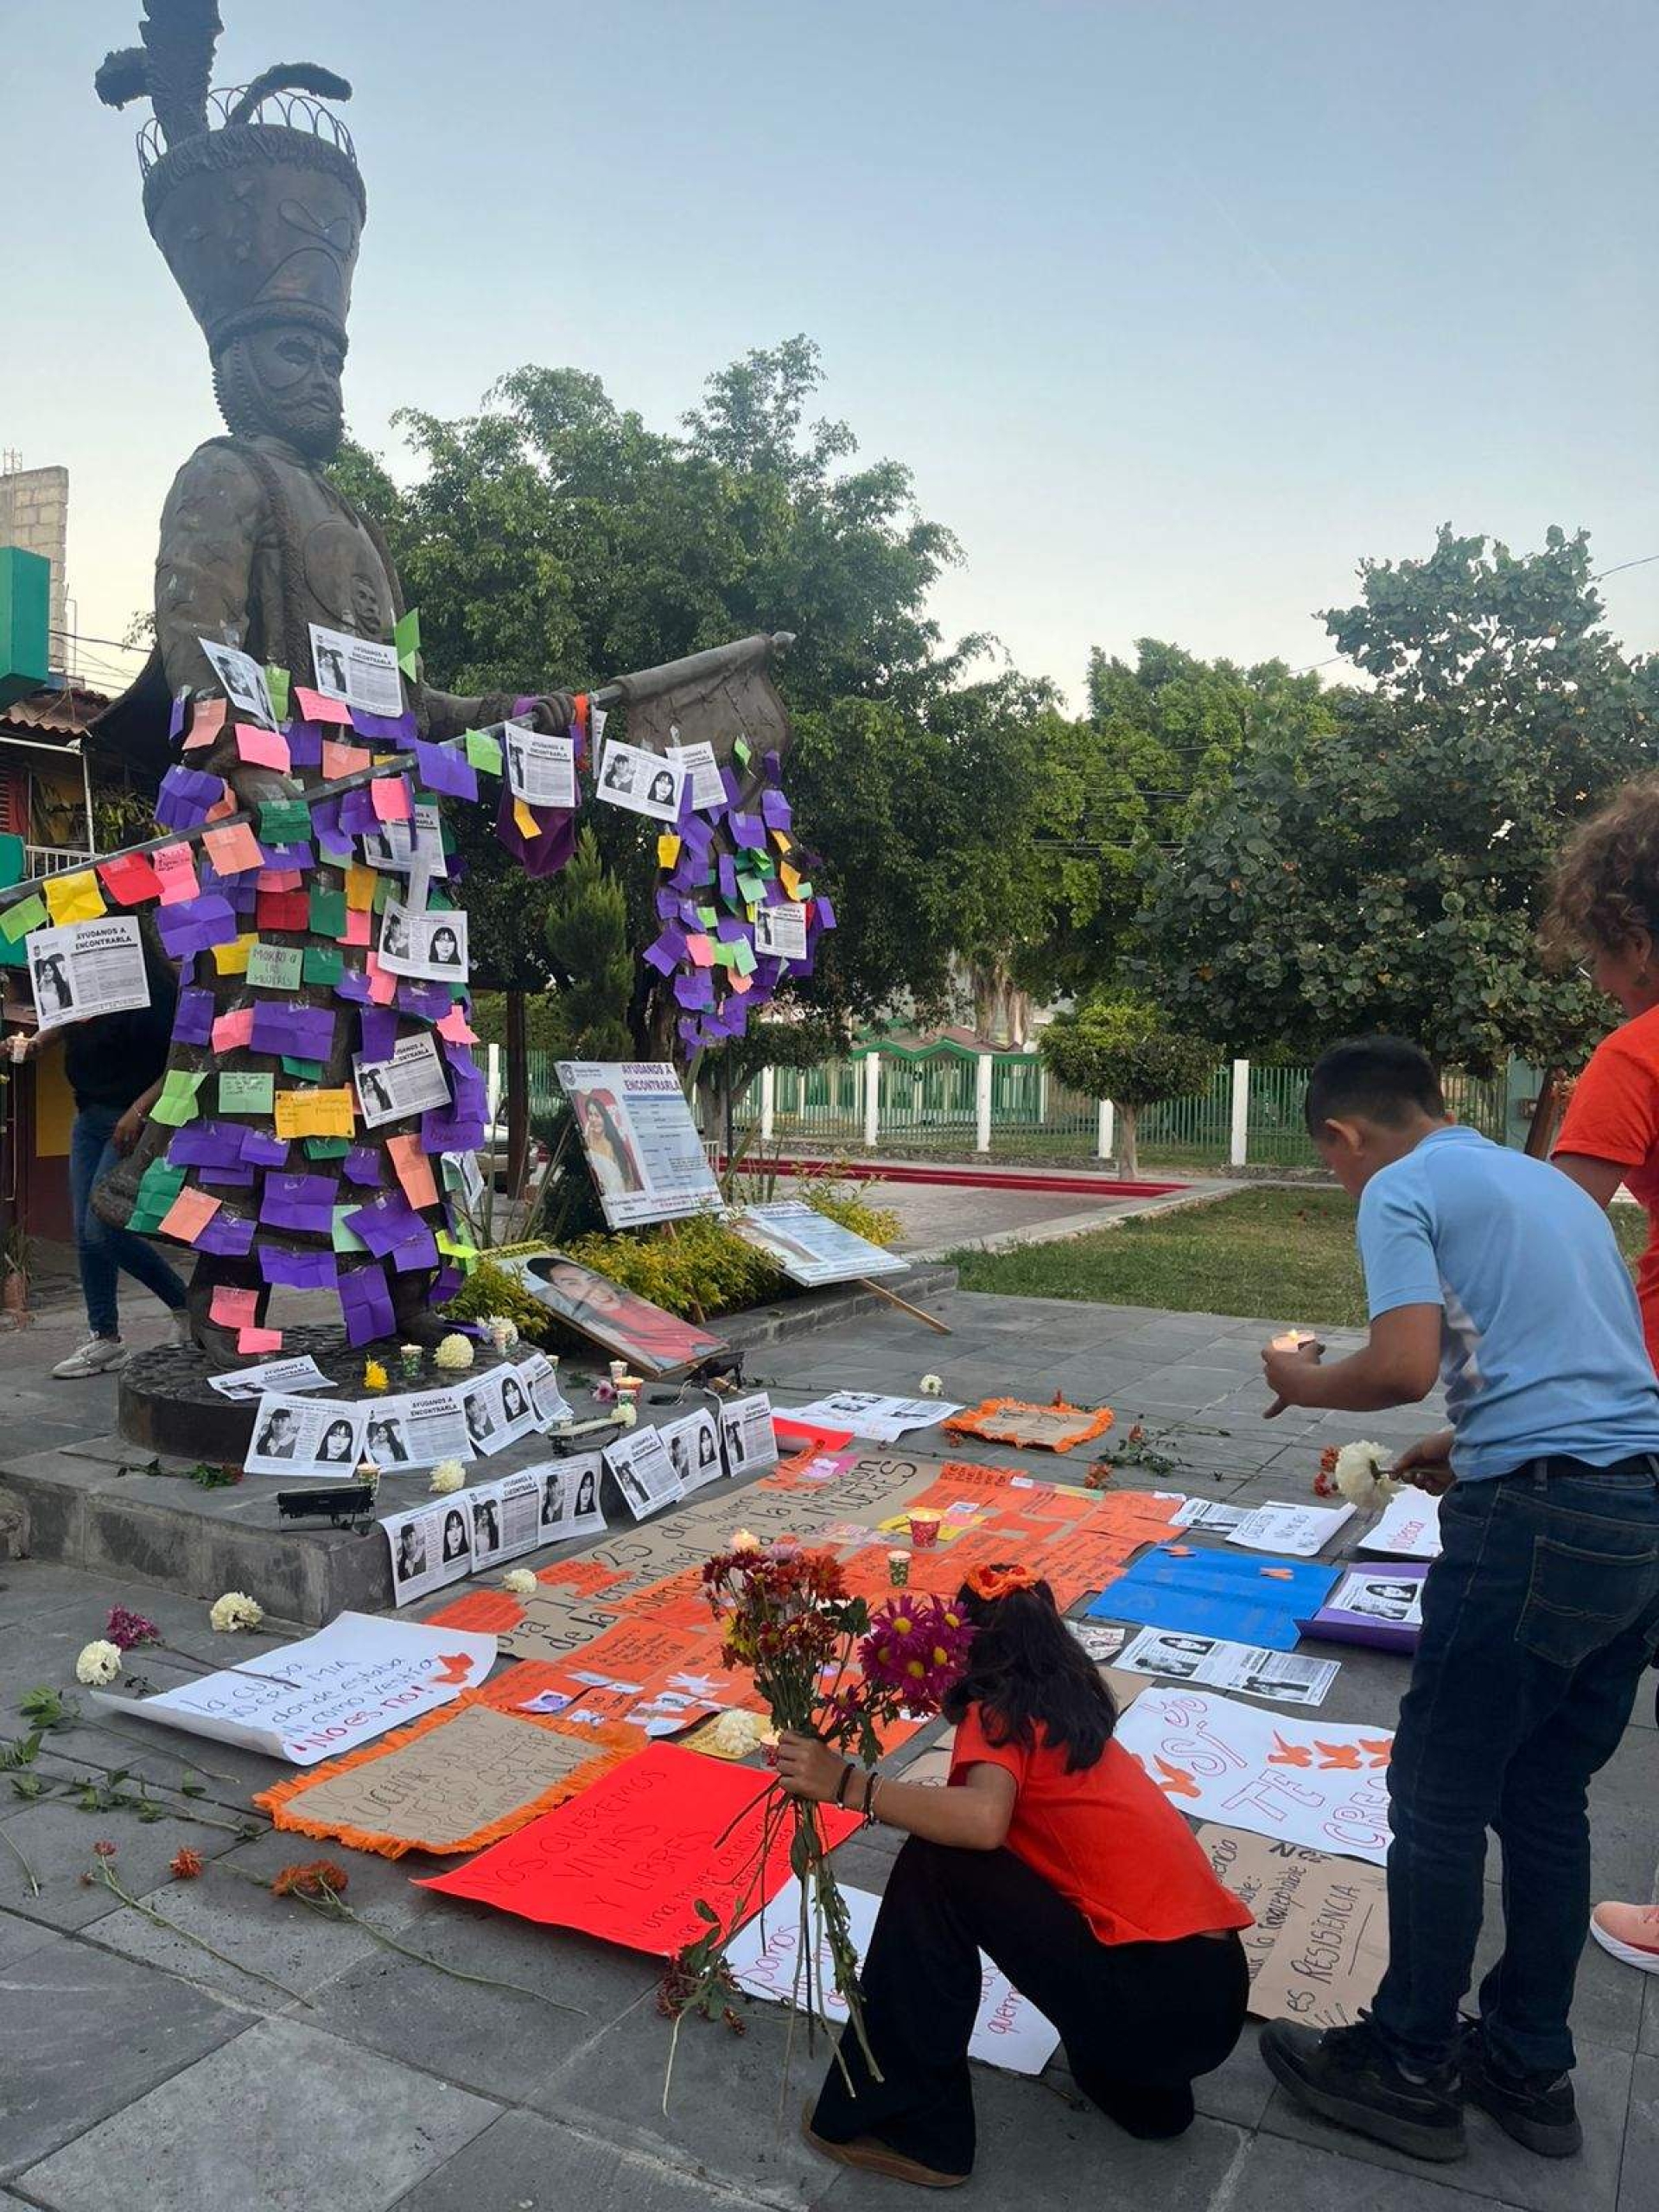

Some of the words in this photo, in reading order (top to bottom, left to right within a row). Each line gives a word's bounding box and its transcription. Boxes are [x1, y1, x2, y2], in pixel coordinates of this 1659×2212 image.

[542, 1630, 594, 1650] de
[569, 1611, 619, 1630] la
[553, 1824, 659, 1878] VIVAS
[613, 1829, 717, 1891] LIBRES
[1286, 1987, 1317, 2013] es
